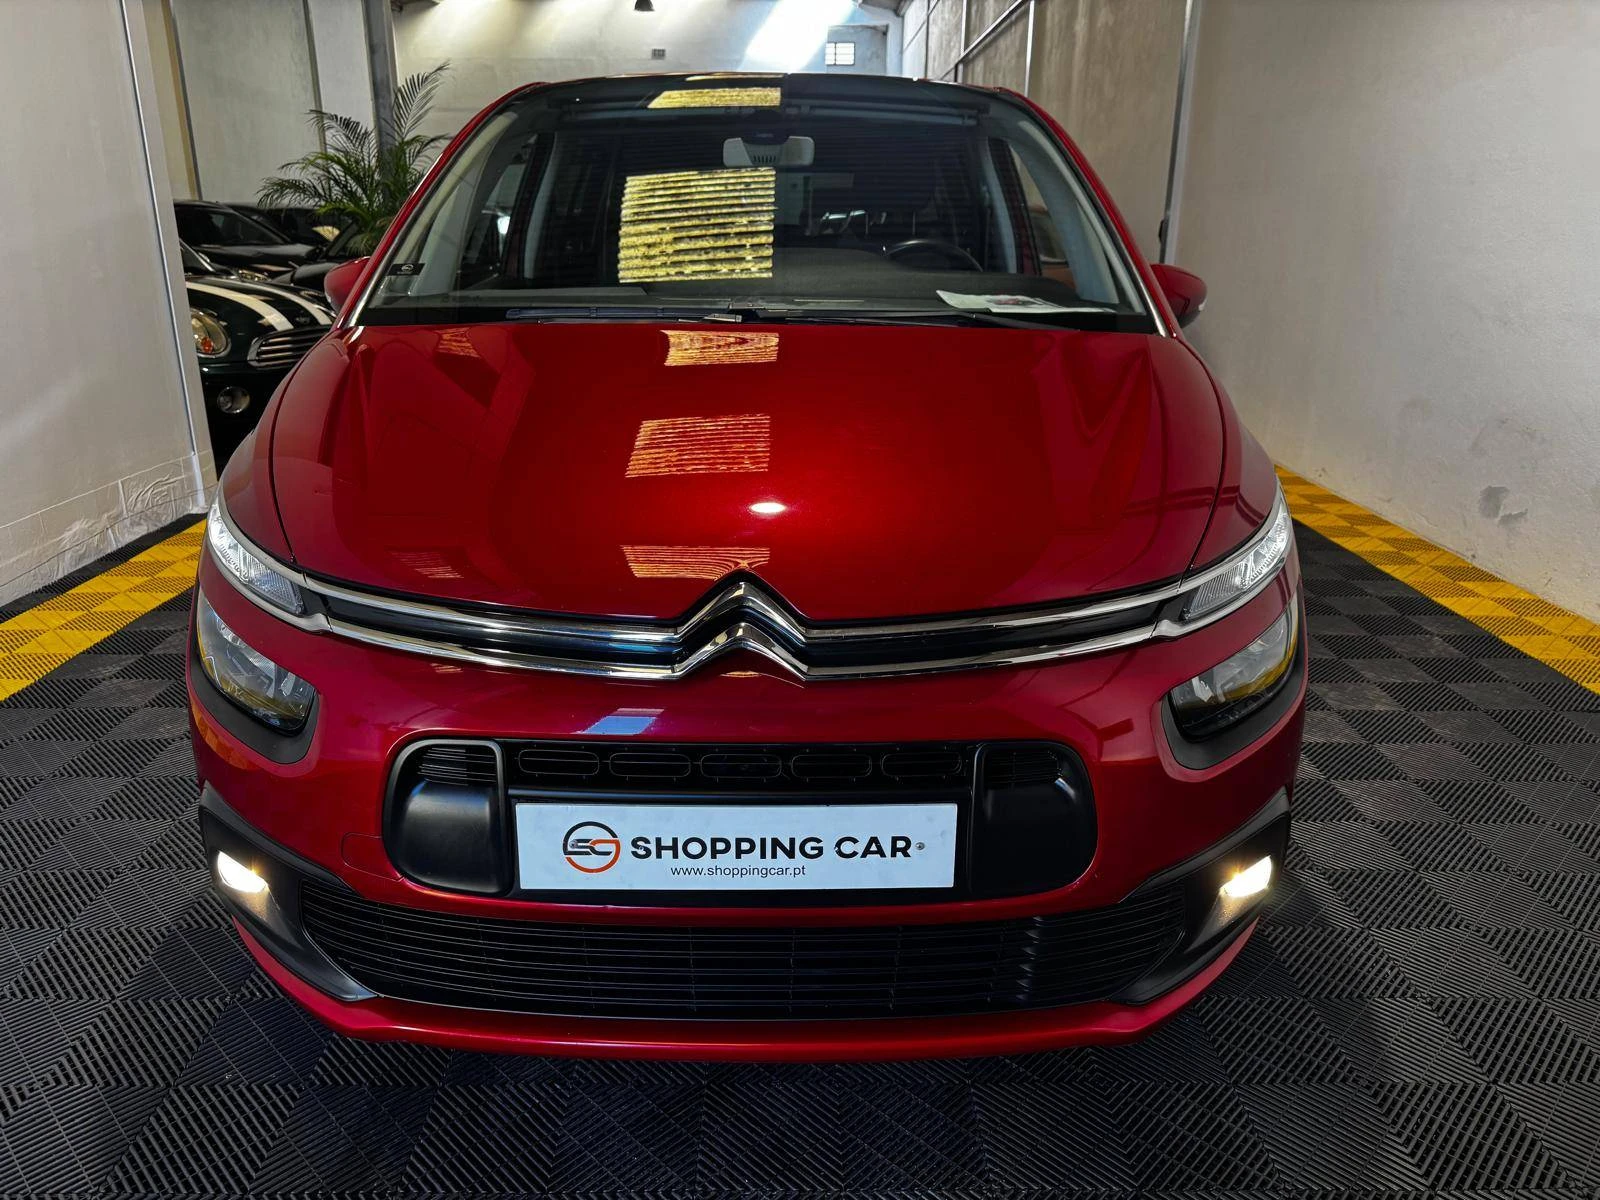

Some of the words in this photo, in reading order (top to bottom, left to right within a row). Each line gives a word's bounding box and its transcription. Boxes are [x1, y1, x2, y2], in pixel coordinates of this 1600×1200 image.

[630, 836, 824, 860] SHOPPING
[834, 835, 912, 859] CAR
[670, 864, 806, 878] www.shoppingcar.pt
